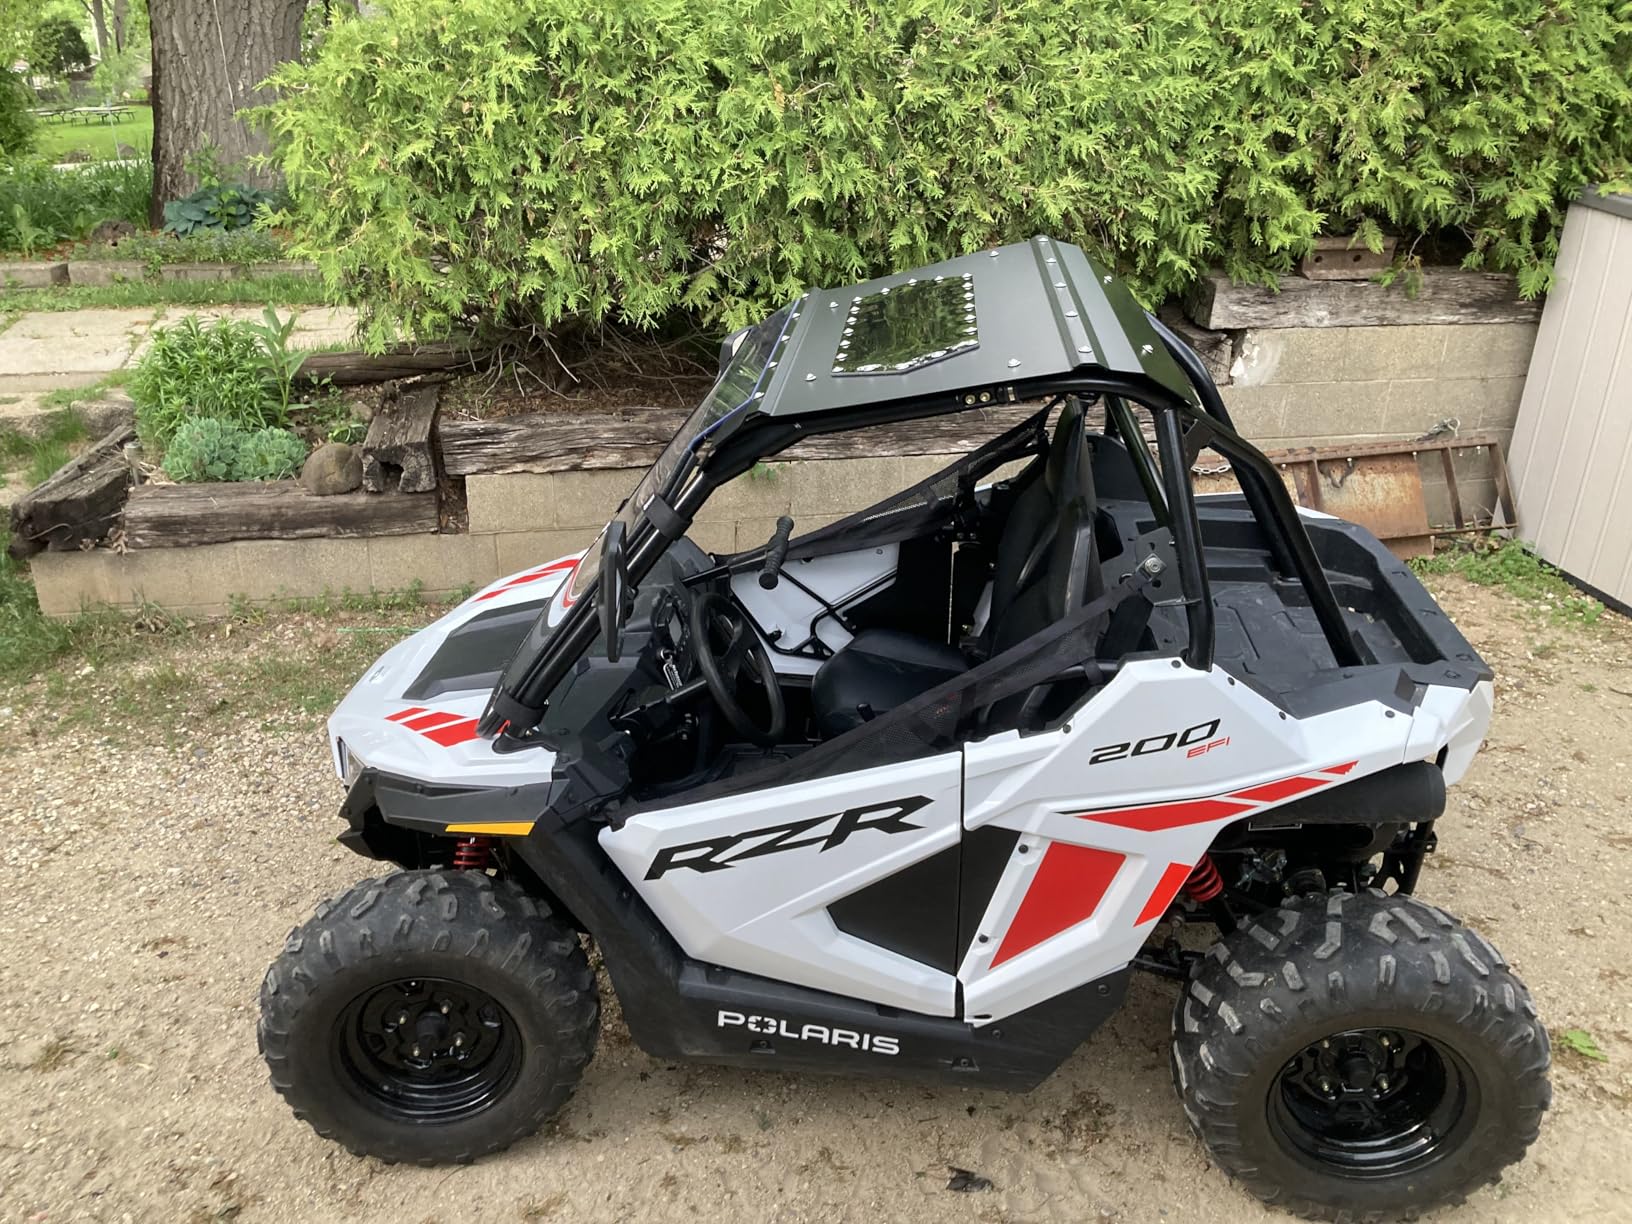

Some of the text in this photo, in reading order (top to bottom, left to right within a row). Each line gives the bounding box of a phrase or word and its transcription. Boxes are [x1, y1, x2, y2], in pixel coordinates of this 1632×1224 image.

[1089, 718, 1221, 765] 200
[1186, 736, 1231, 758] EFI
[643, 795, 935, 881] RZR
[717, 1010, 900, 1055] POLARIS
